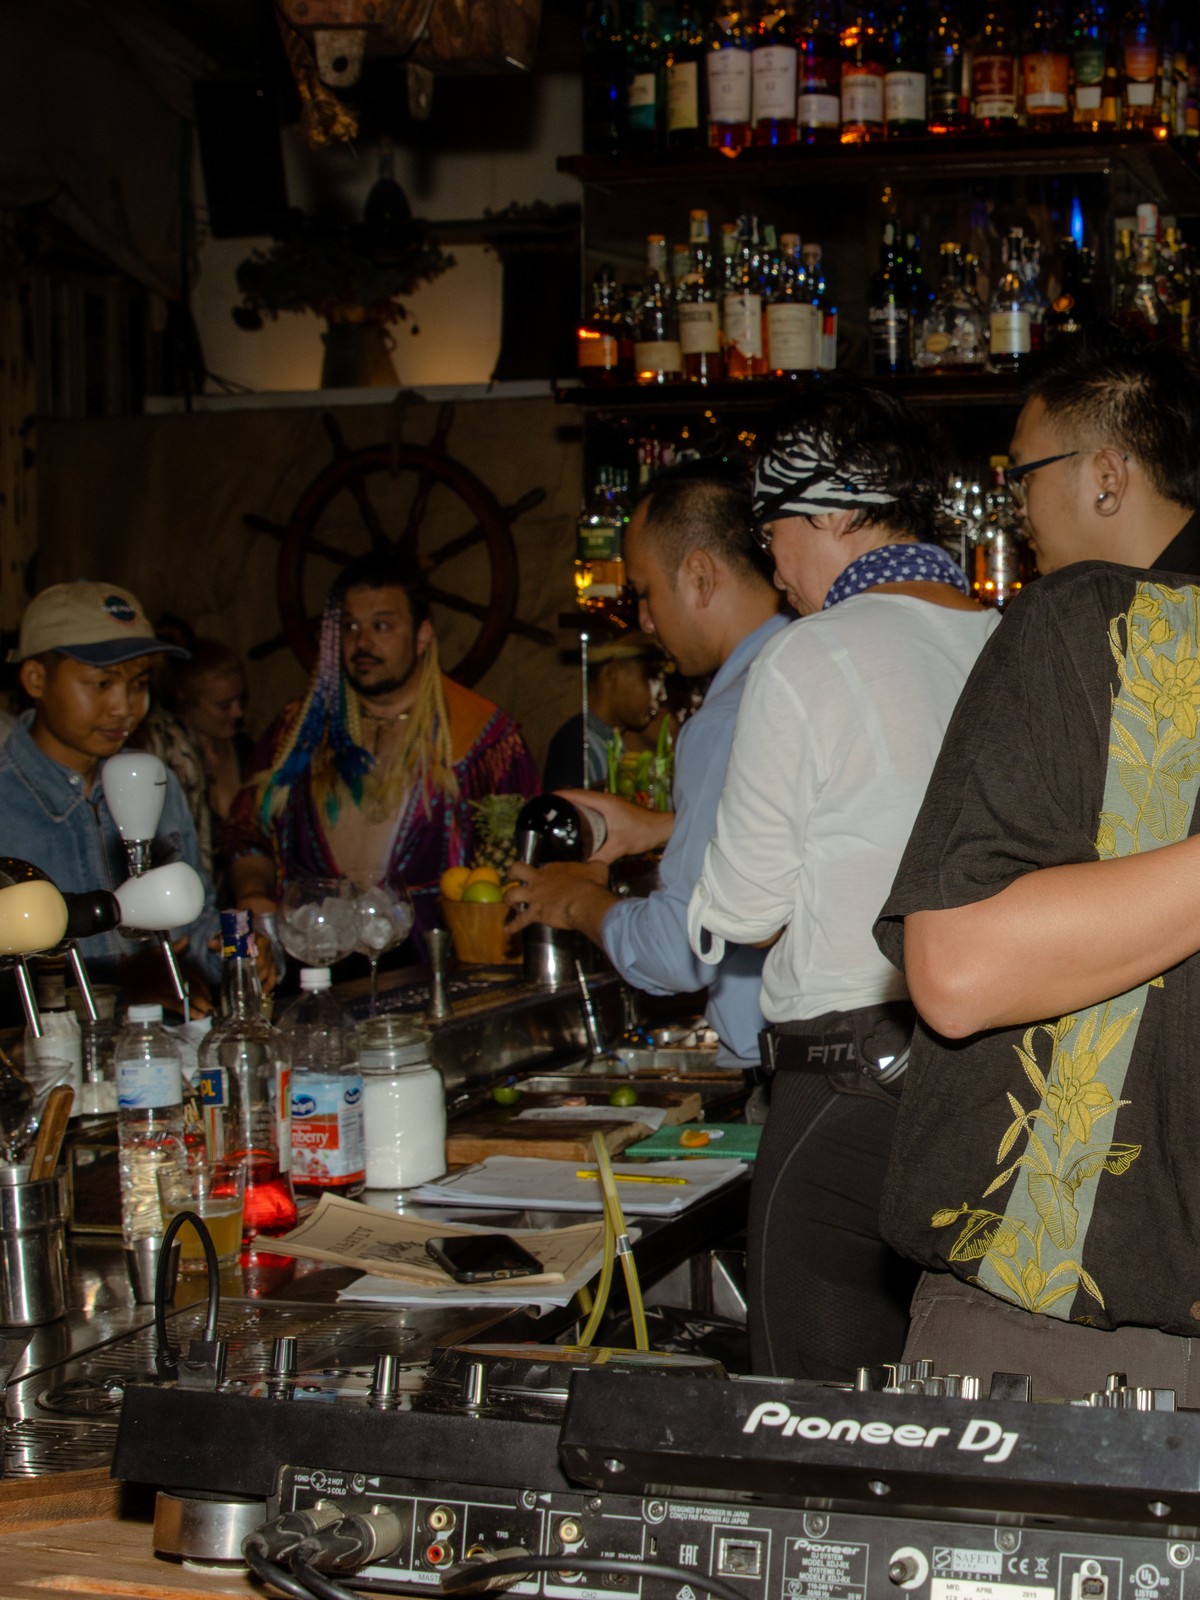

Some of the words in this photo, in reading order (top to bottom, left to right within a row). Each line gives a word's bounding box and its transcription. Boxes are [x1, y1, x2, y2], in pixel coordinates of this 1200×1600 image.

[742, 1401, 950, 1448] Pioneer
[957, 1419, 1019, 1464] DJ
[793, 1540, 860, 1556] Pioneer
[955, 1552, 999, 1566] SAFETY
[1022, 1591, 1038, 1599] 2015
[1135, 1589, 1159, 1599] LISTED
